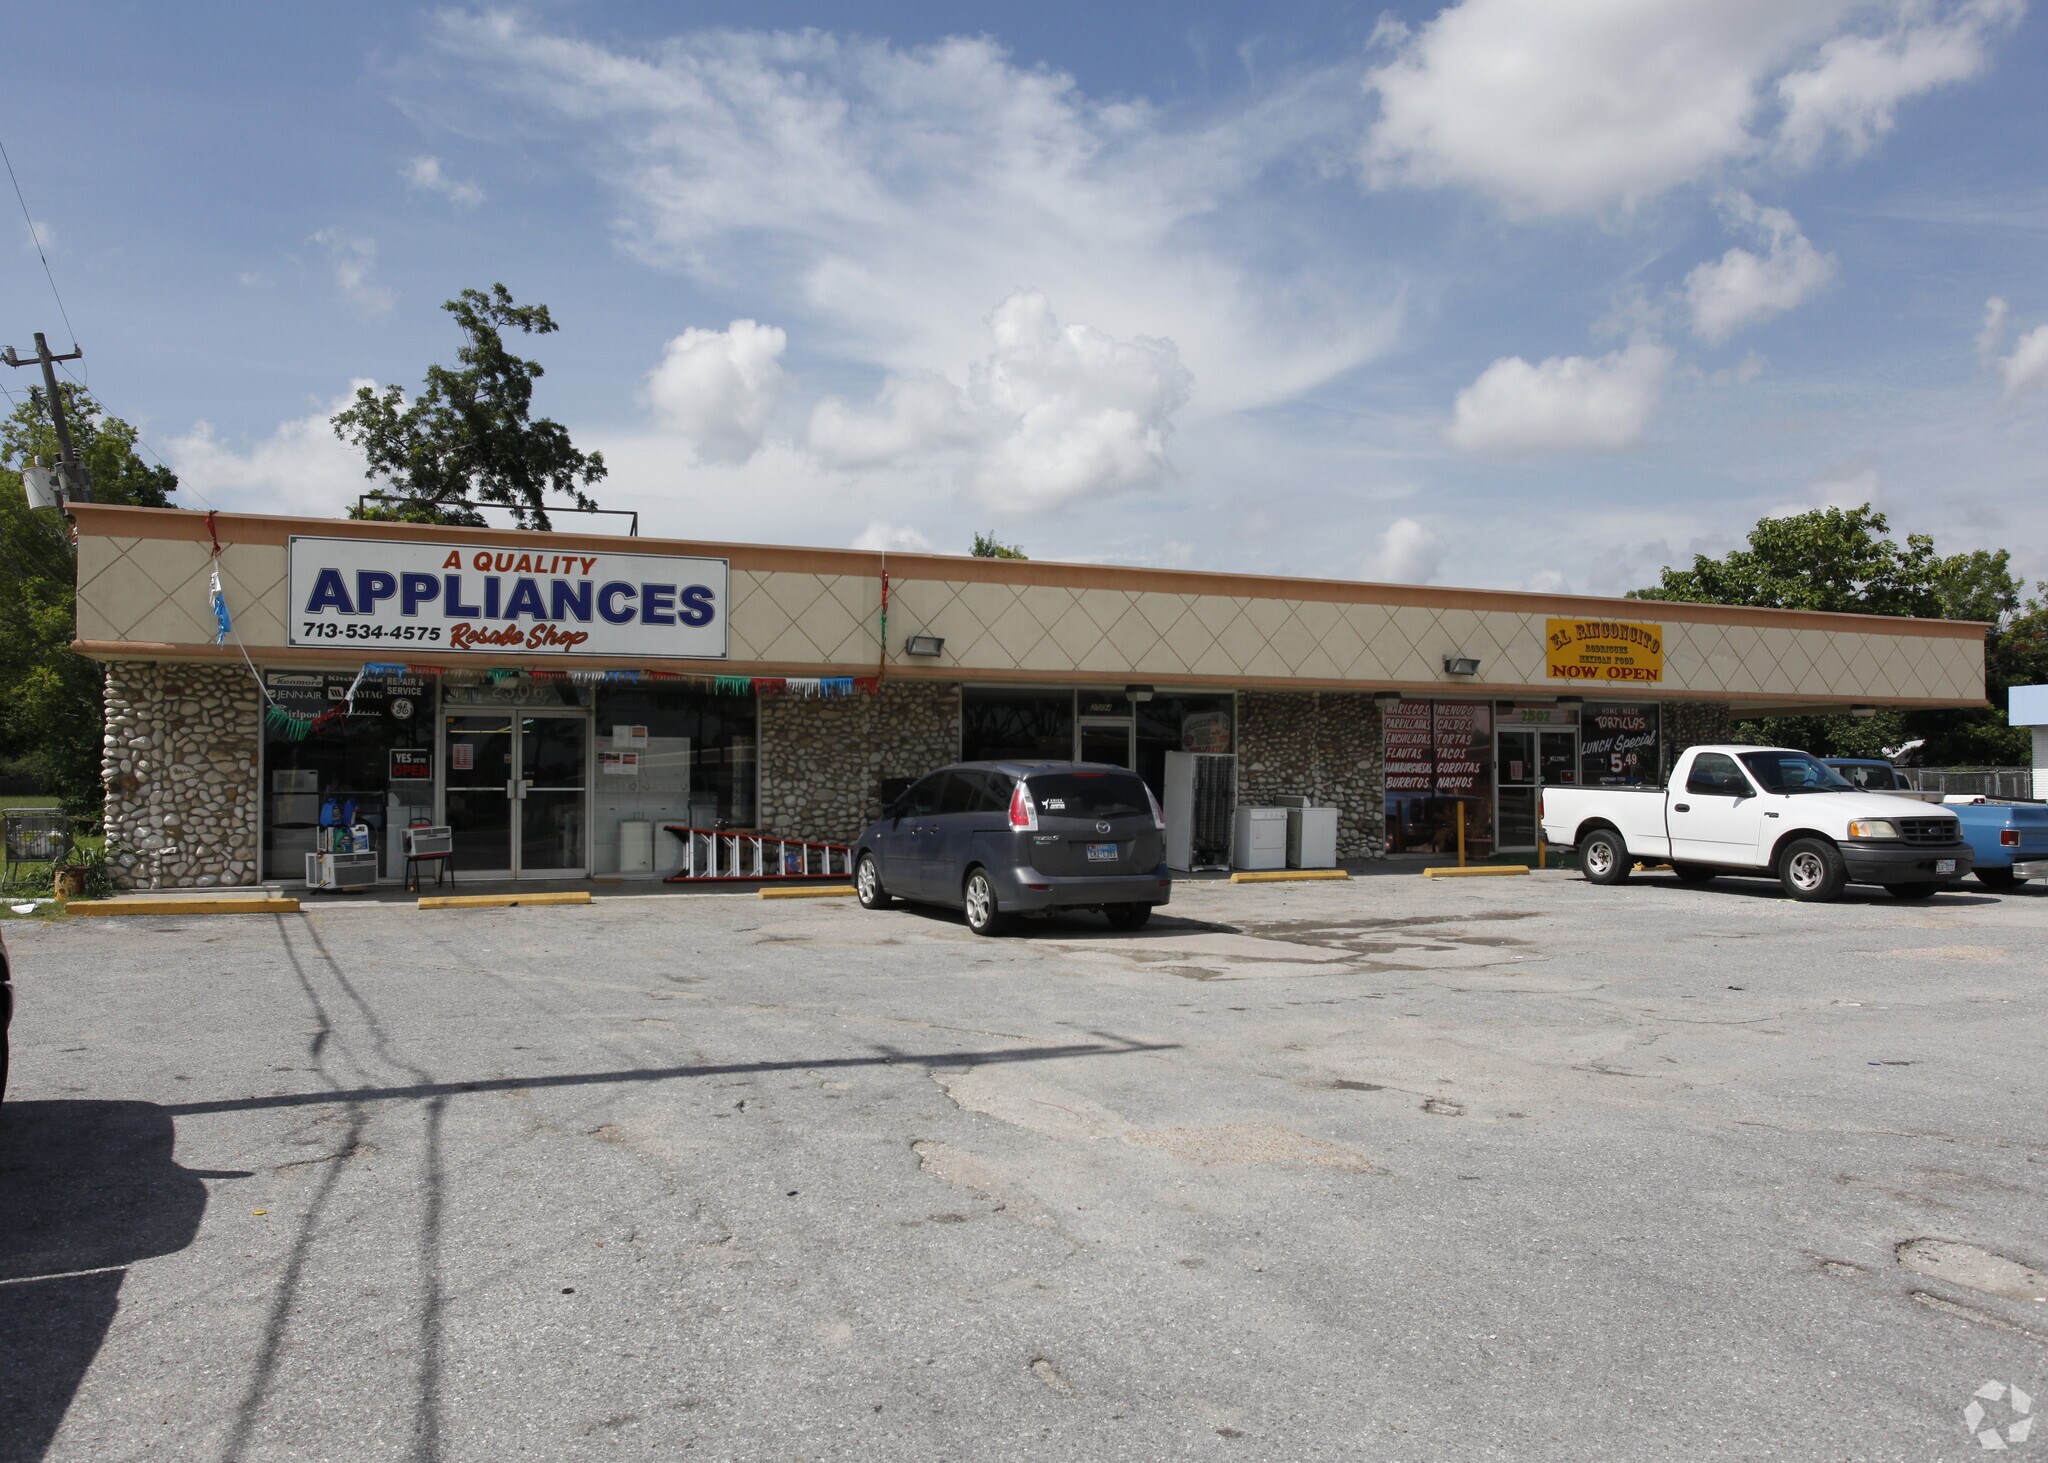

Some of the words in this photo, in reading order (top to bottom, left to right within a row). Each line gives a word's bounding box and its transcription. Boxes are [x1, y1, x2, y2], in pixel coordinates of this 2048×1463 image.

[441, 550, 463, 570] A
[471, 551, 598, 576] QUALITY
[305, 567, 716, 628] APPLIANCES
[303, 622, 442, 641] 713-534-4575
[450, 623, 525, 650] Resale
[526, 624, 589, 652] Shop
[1550, 629, 1572, 651] EL
[1575, 622, 1660, 654] RINCONCITO
[1615, 656, 1635, 665] FOOD
[1552, 664, 1599, 678] NOW
[1606, 666, 1659, 680] OPEN
[276, 678, 322, 686] Kenmore
[328, 674, 383, 683] KitchnAid
[387, 677, 416, 686] REPAIR
[418, 678, 425, 687] &
[276, 689, 322, 700] JENN-AIR
[348, 690, 383, 699] AYTAG
[387, 686, 422, 695] SERVICE
[272, 709, 321, 720] hirlpool
[1385, 703, 1430, 716] MARISCOS
[1436, 704, 1474, 716] MENUDO
[1601, 707, 1618, 715] HOME
[1623, 707, 1639, 715] MADE
[1520, 710, 1551, 722] 2502
[1384, 718, 1431, 730] PARRILLADAS
[1437, 719, 1472, 731] CALDOS
[1385, 732, 1431, 744] ENCHILADAS
[1436, 733, 1472, 745] TORTAS
[1581, 738, 1611, 755] LUNCH
[1614, 729, 1656, 753] Special
[395, 753, 412, 763] YES
[1385, 747, 1423, 759] FLAUTAS
[1436, 748, 1466, 760] TACOS
[1384, 762, 1432, 774] HAMBURGUESAS
[1436, 762, 1480, 773] GORDITAS
[1610, 753, 1637, 773] 5.49
[393, 764, 429, 777] OPEN
[1385, 776, 1430, 788] BURRITOS
[1436, 776, 1473, 789] NACHOS
